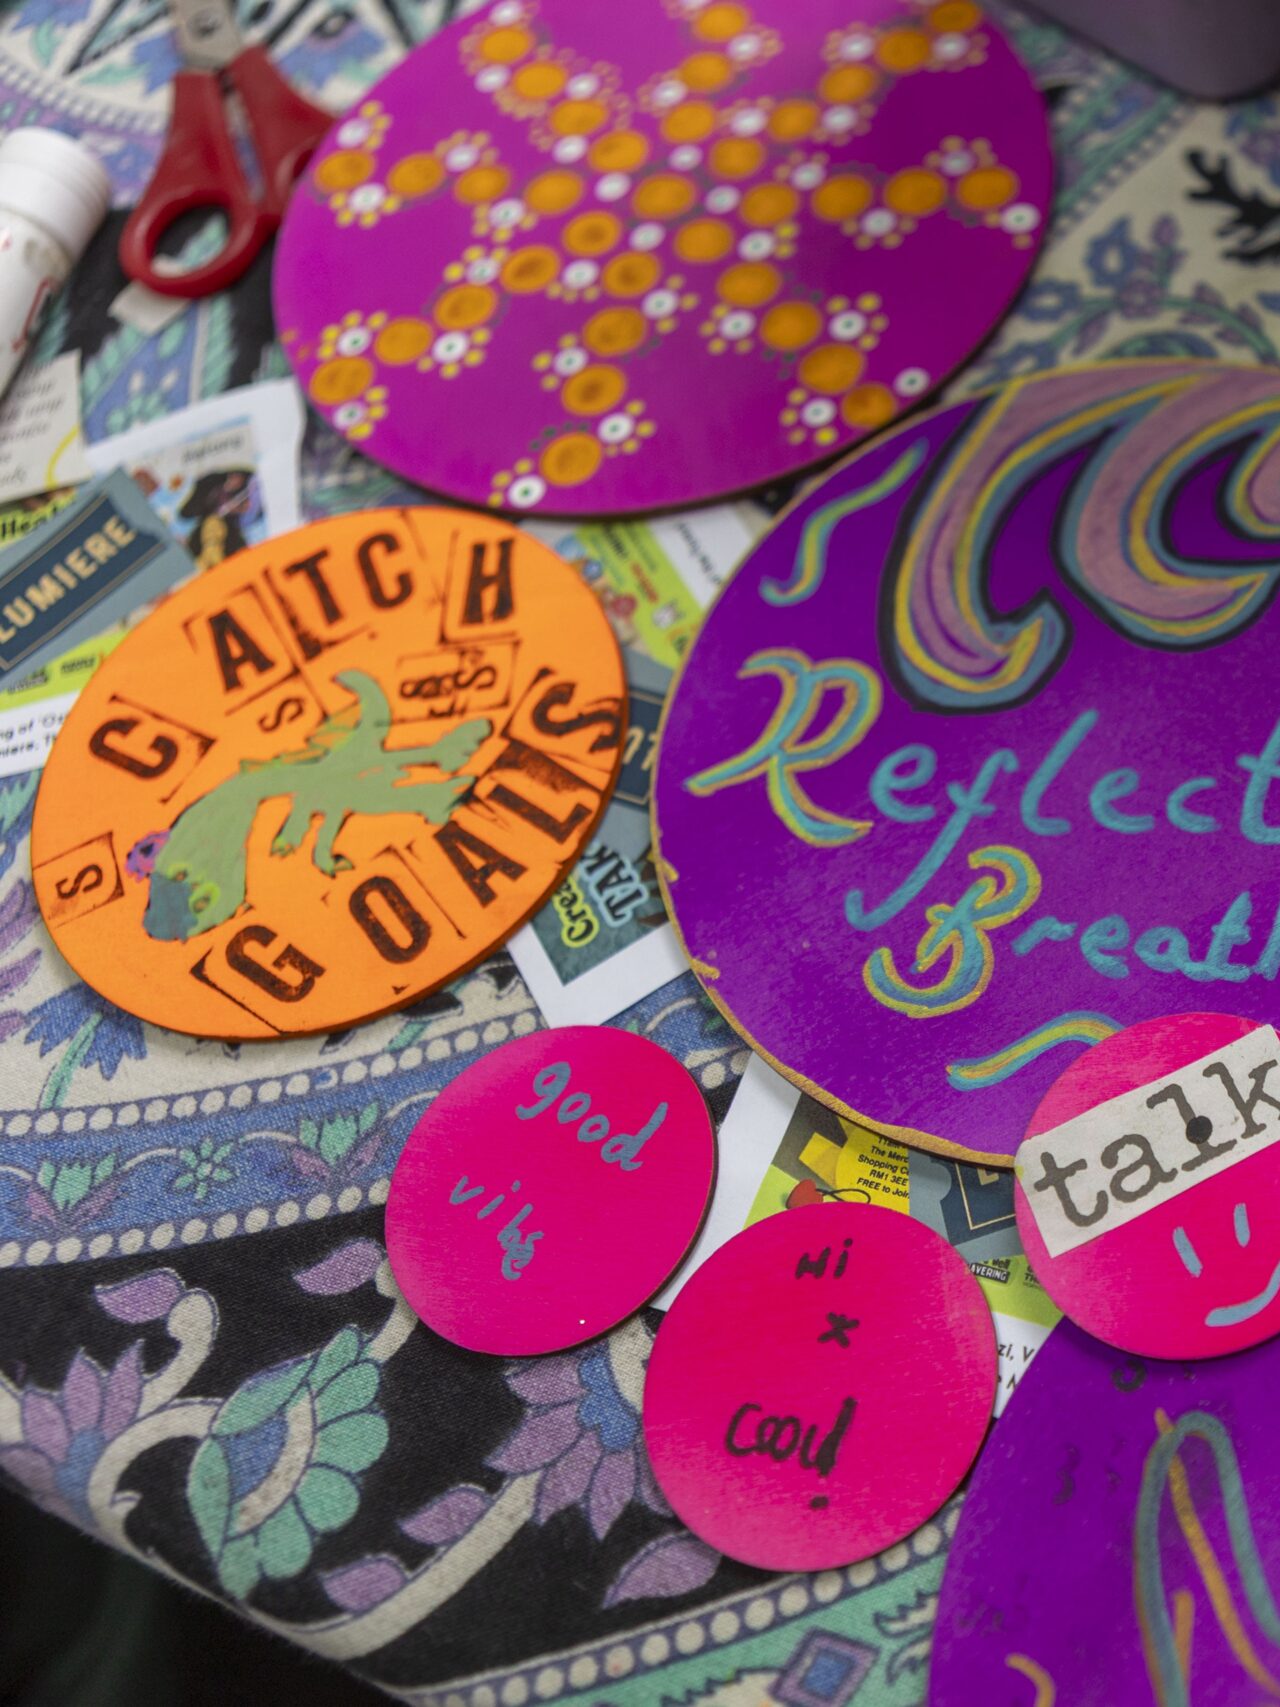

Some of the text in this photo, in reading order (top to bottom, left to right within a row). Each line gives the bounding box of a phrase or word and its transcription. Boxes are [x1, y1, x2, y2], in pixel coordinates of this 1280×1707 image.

[515, 1061, 668, 1171] good
[872, 1145, 886, 1157] The
[858, 1154, 899, 1173] Shopping
[857, 1177, 881, 1191] FREE
[882, 1185, 891, 1194] to
[869, 1169, 909, 1187] RM1 3EE
[795, 1238, 853, 1279] Hi
